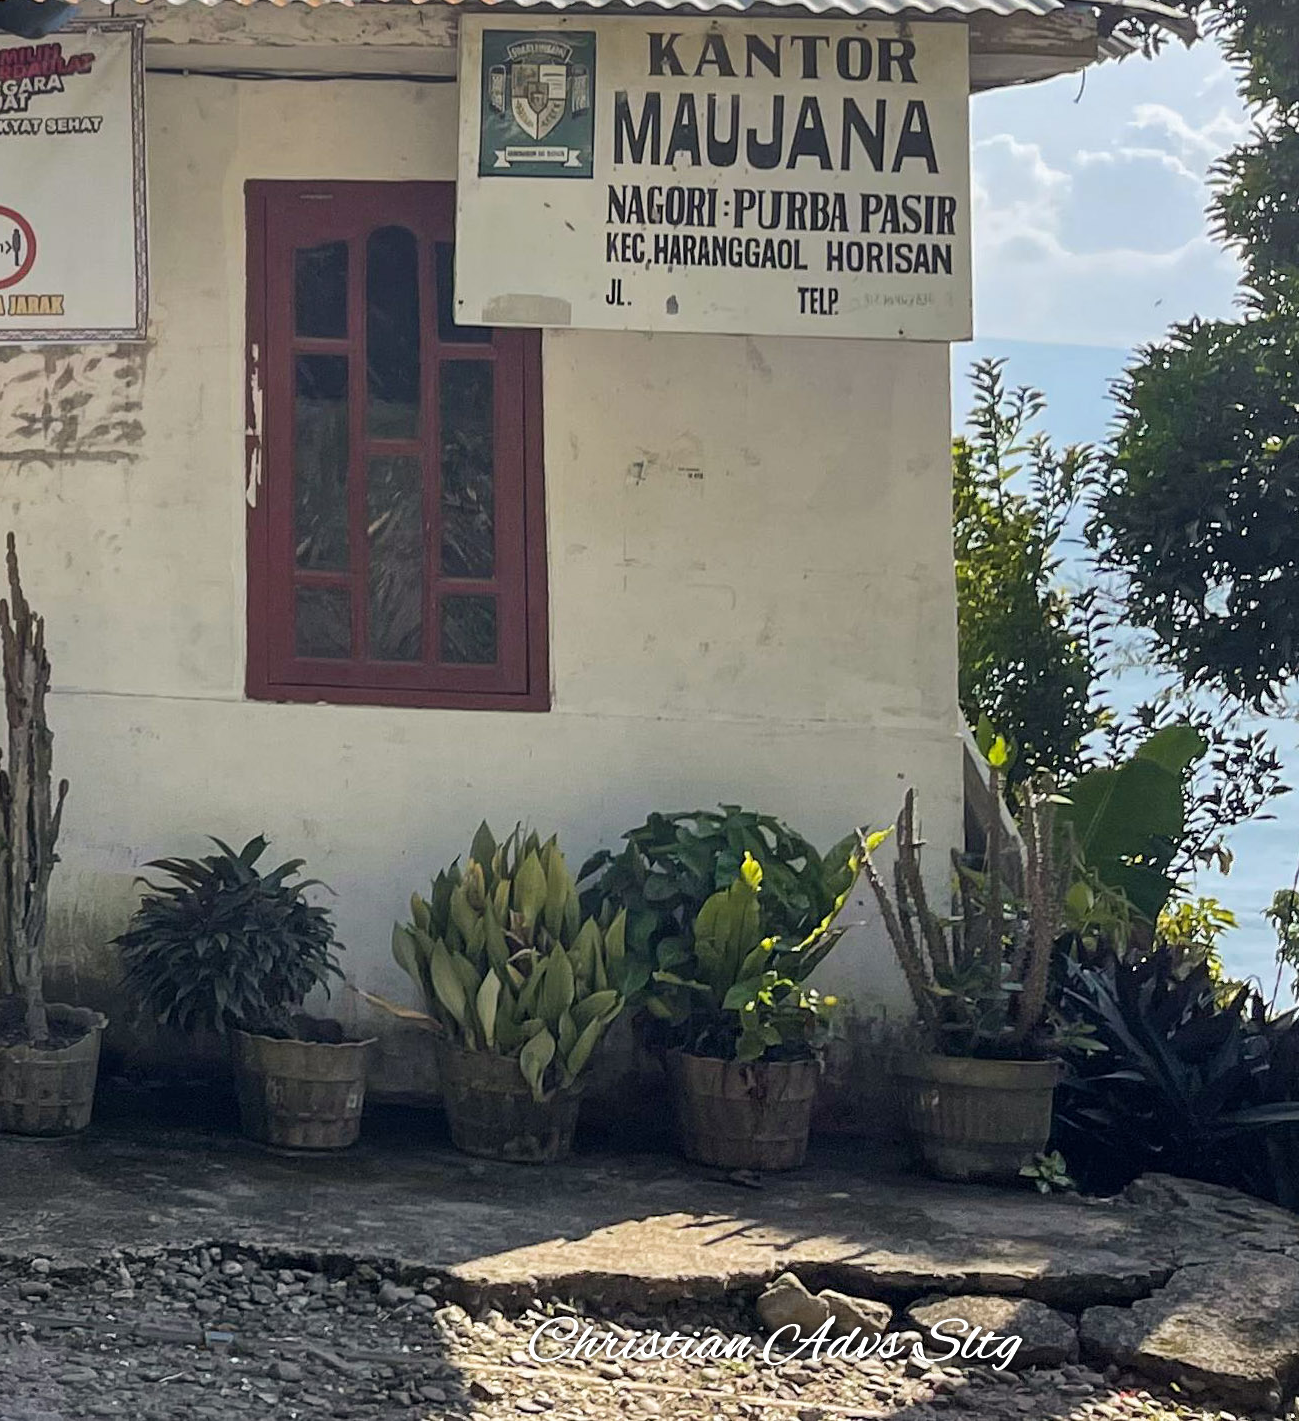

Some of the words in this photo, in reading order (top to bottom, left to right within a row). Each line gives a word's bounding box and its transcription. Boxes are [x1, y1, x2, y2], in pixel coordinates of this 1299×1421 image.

[647, 31, 917, 84] KANTOR
[45, 116, 102, 134] SEHAT
[613, 91, 940, 174] MAUJANA
[733, 189, 849, 233] PURBA
[860, 193, 957, 235] PASIR
[826, 241, 952, 275] HORISAN
[8, 295, 64, 315] JARAK
[606, 278, 632, 307] JL.
[797, 286, 839, 316] TELP.
